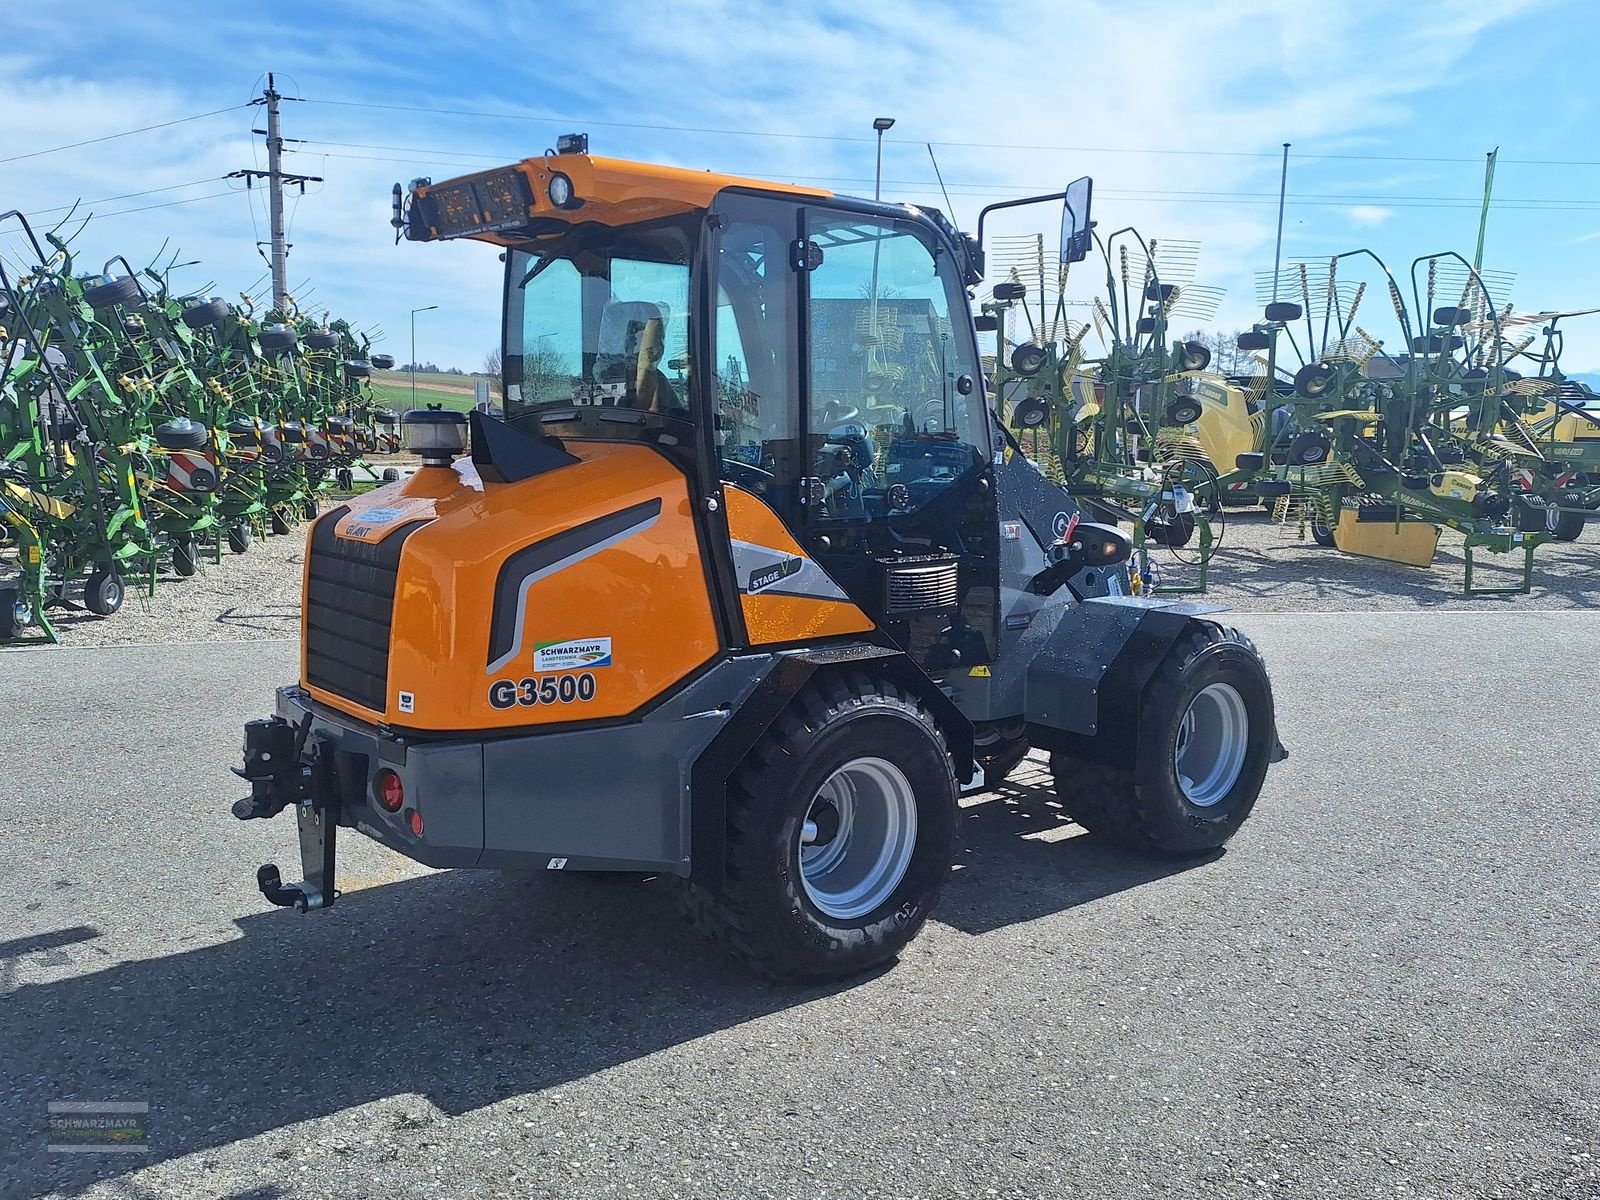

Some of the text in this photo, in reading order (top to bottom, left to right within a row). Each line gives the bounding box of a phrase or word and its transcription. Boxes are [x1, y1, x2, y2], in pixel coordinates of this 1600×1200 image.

[345, 523, 372, 537] GIANT
[752, 571, 780, 588] STAGE
[540, 645, 601, 656] SCHWARZMAYR
[488, 672, 596, 710] G3500
